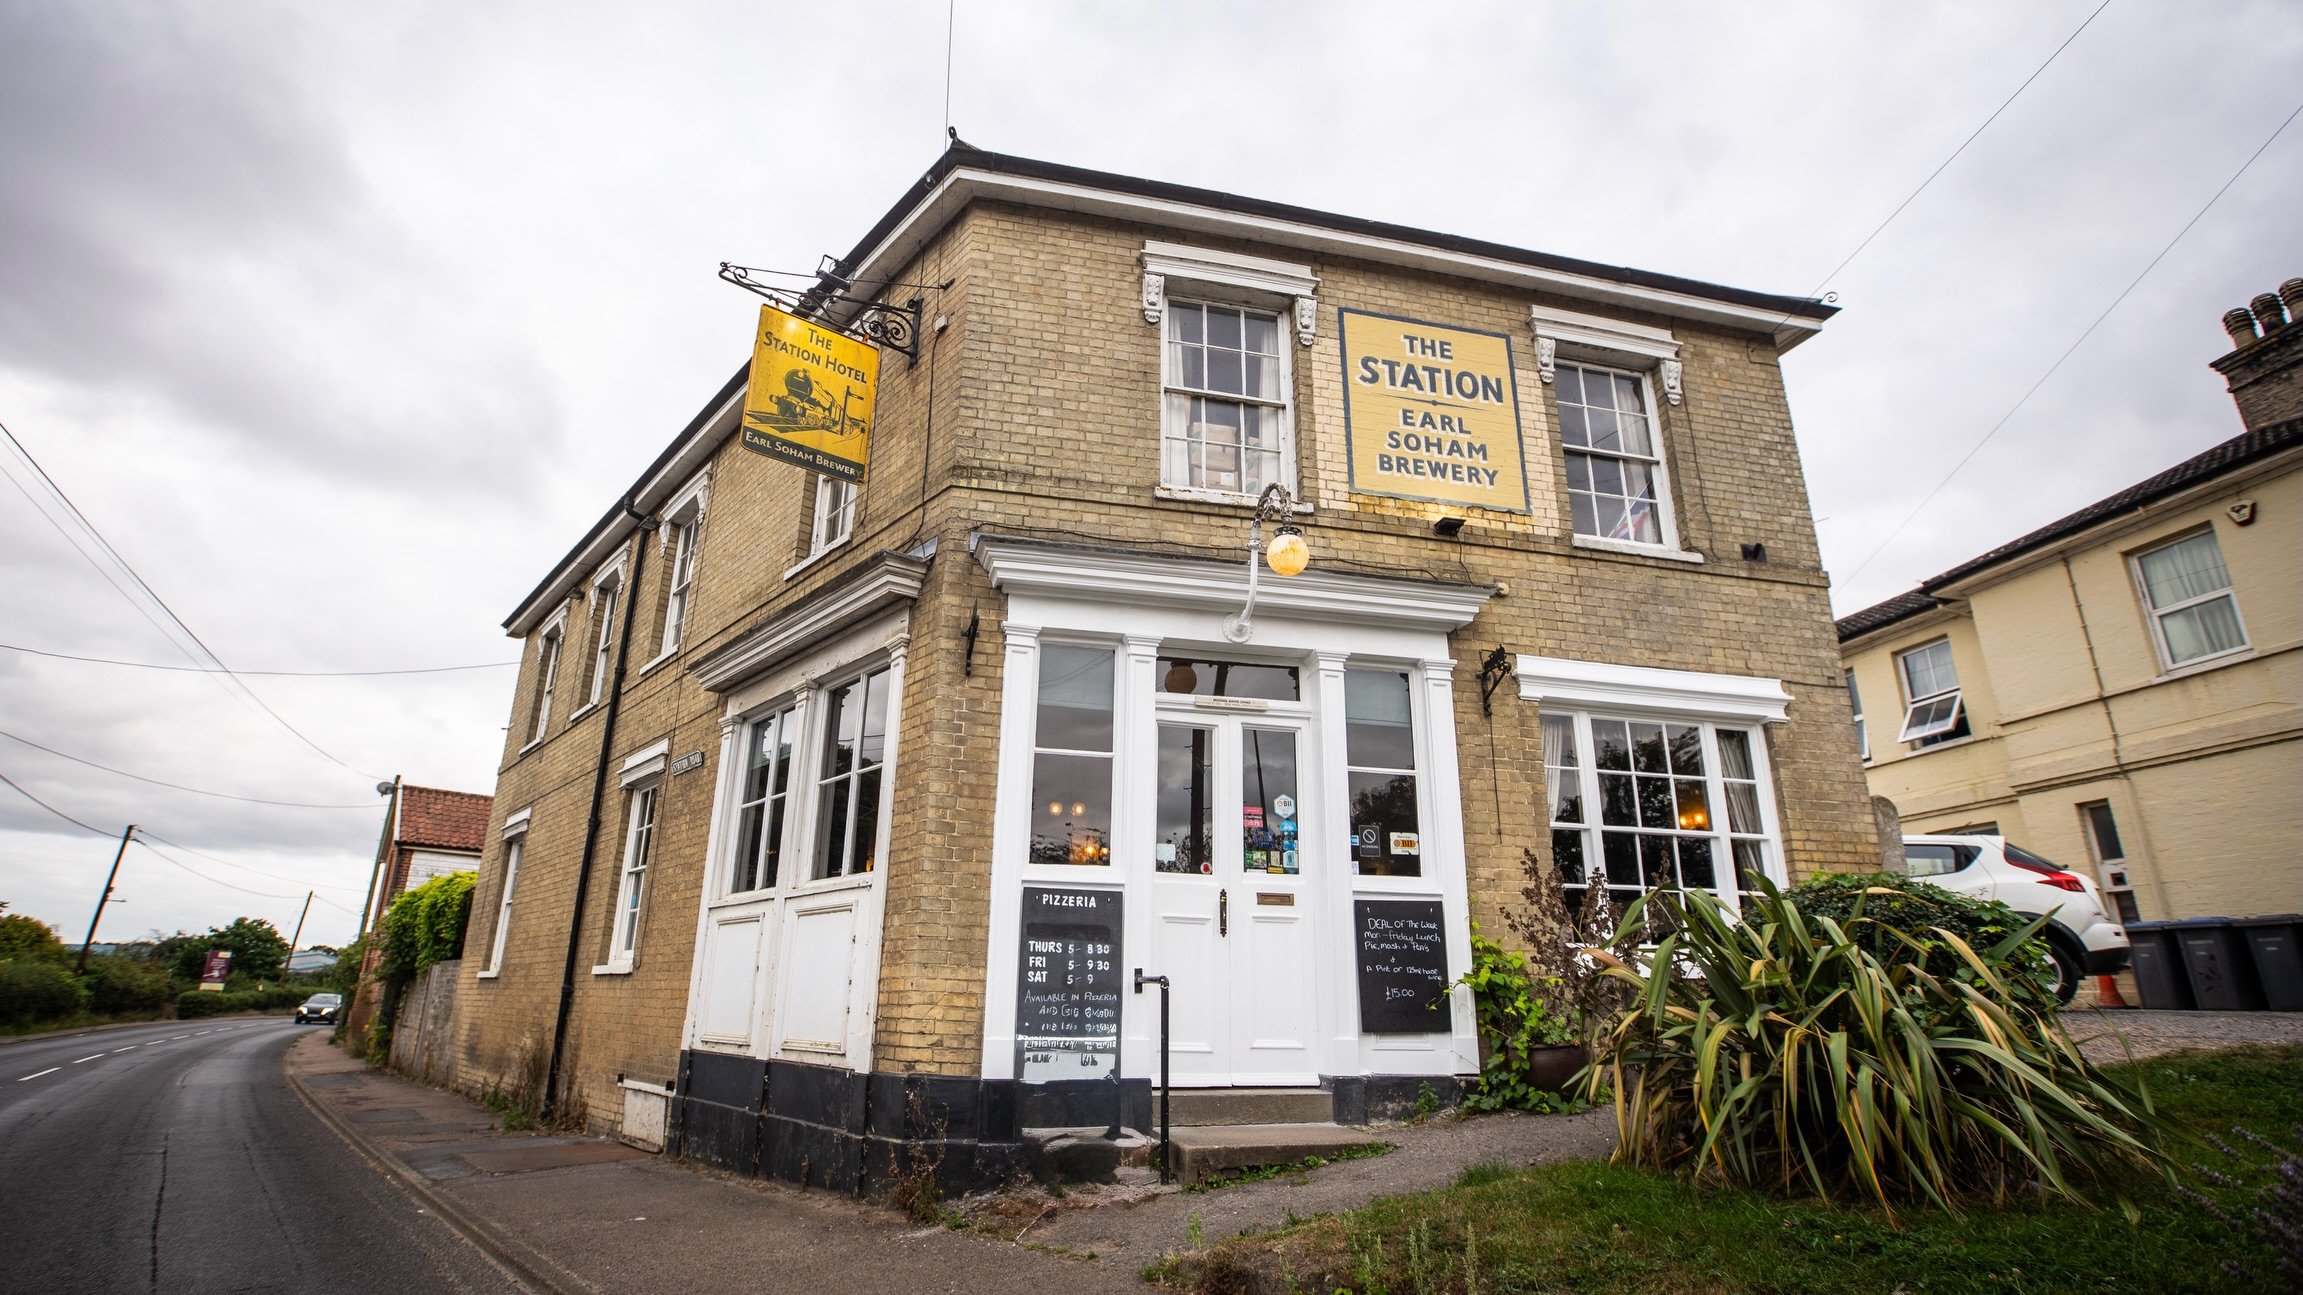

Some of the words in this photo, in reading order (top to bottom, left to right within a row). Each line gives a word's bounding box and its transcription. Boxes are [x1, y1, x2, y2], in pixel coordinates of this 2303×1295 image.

[807, 328, 832, 351] THE
[1402, 334, 1454, 361] THE
[763, 331, 821, 366] STATION
[825, 354, 867, 384] HOTEL
[1357, 355, 1504, 404] STATION
[1400, 408, 1472, 437] EARL
[745, 431, 772, 449] EARL
[775, 441, 813, 462] SOHAM
[816, 454, 862, 477] BREWERY
[1386, 430, 1488, 463] SOHAM
[1376, 453, 1499, 488] BREWERY
[1042, 894, 1097, 908] PIZZERIA
[1367, 918, 1393, 930] DEAL
[1028, 941, 1063, 954] THURS
[1068, 943, 1075, 955] 5
[1029, 956, 1046, 968] FRI
[1067, 959, 1075, 971] 5
[1366, 965, 1373, 973] A
[1027, 971, 1048, 983] SAT
[1066, 974, 1074, 985] 5
[1087, 973, 1094, 985] 9
[1024, 989, 1067, 1003] AVAILABLE
[1071, 993, 1080, 1001] IN
[1084, 991, 1118, 1001] PIZZERIA
